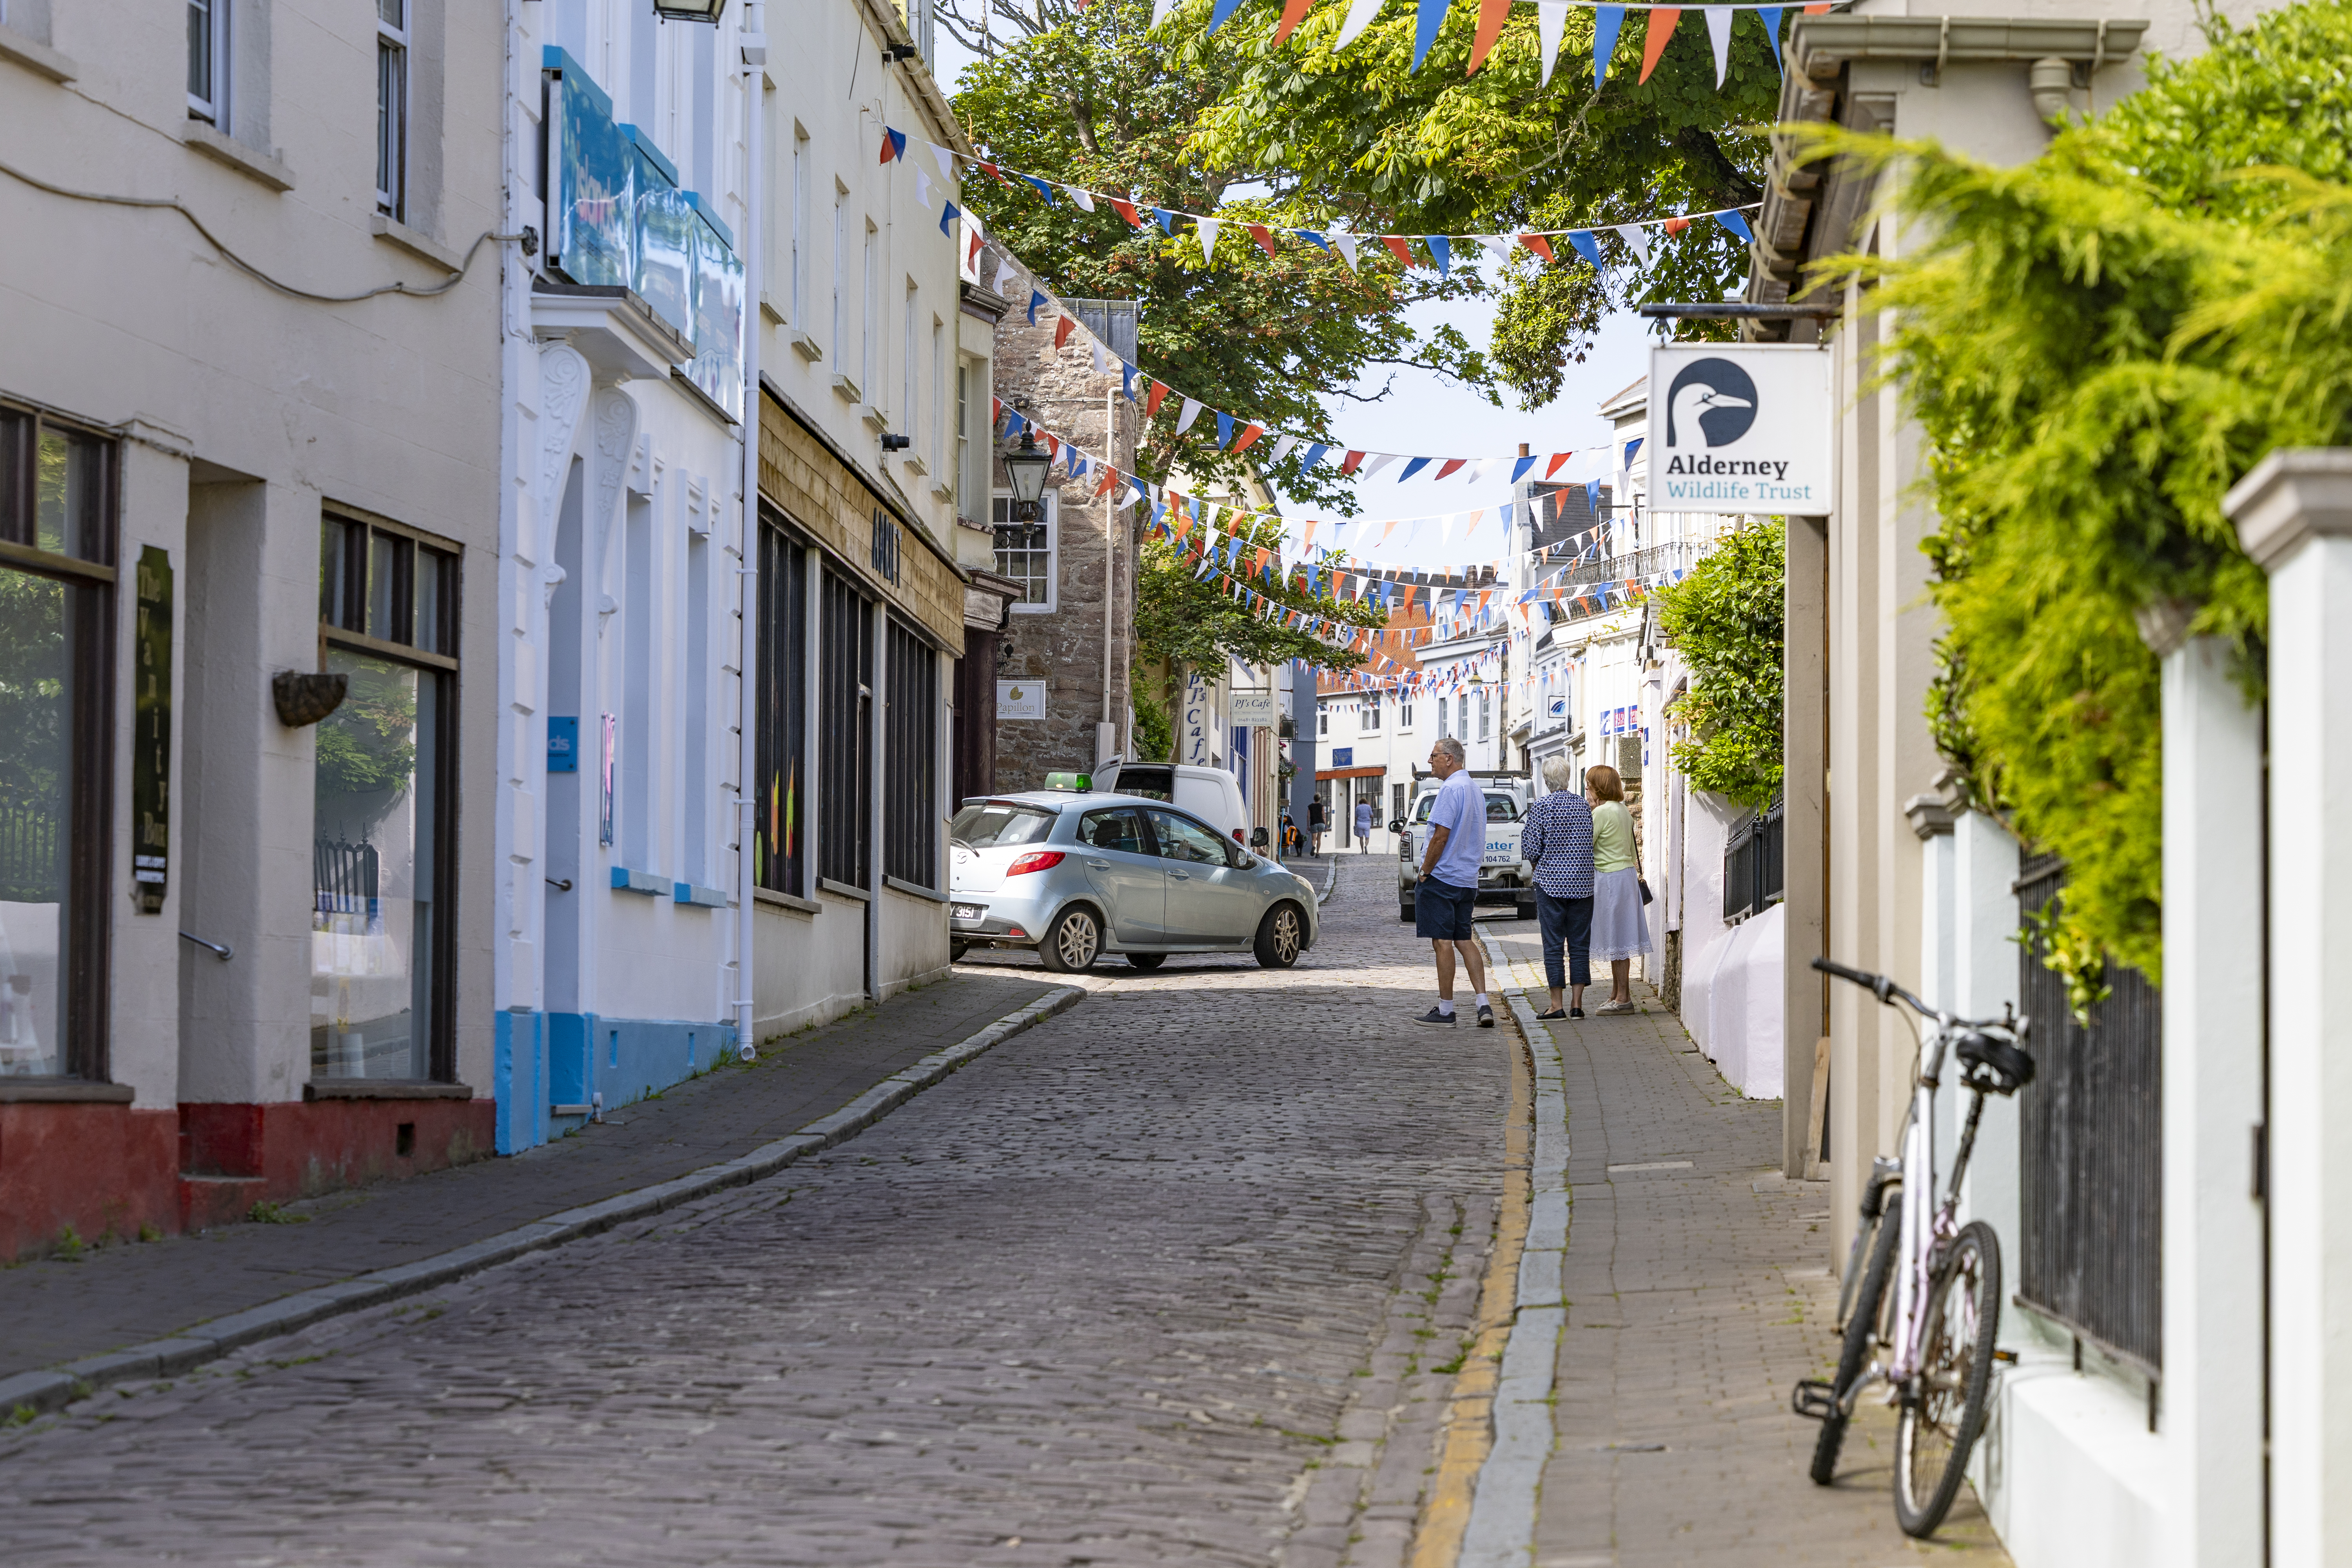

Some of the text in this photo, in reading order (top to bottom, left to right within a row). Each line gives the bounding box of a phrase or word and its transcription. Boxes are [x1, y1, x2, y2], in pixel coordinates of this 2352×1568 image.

[1666, 455, 1789, 481] Alderney
[1667, 481, 1812, 499] Wildlife Trust
[996, 702, 1035, 714] Papillon
[1235, 699, 1270, 710] PJ's Café
[1485, 841, 1514, 849] ater
[950, 906, 975, 918] Y 3151
